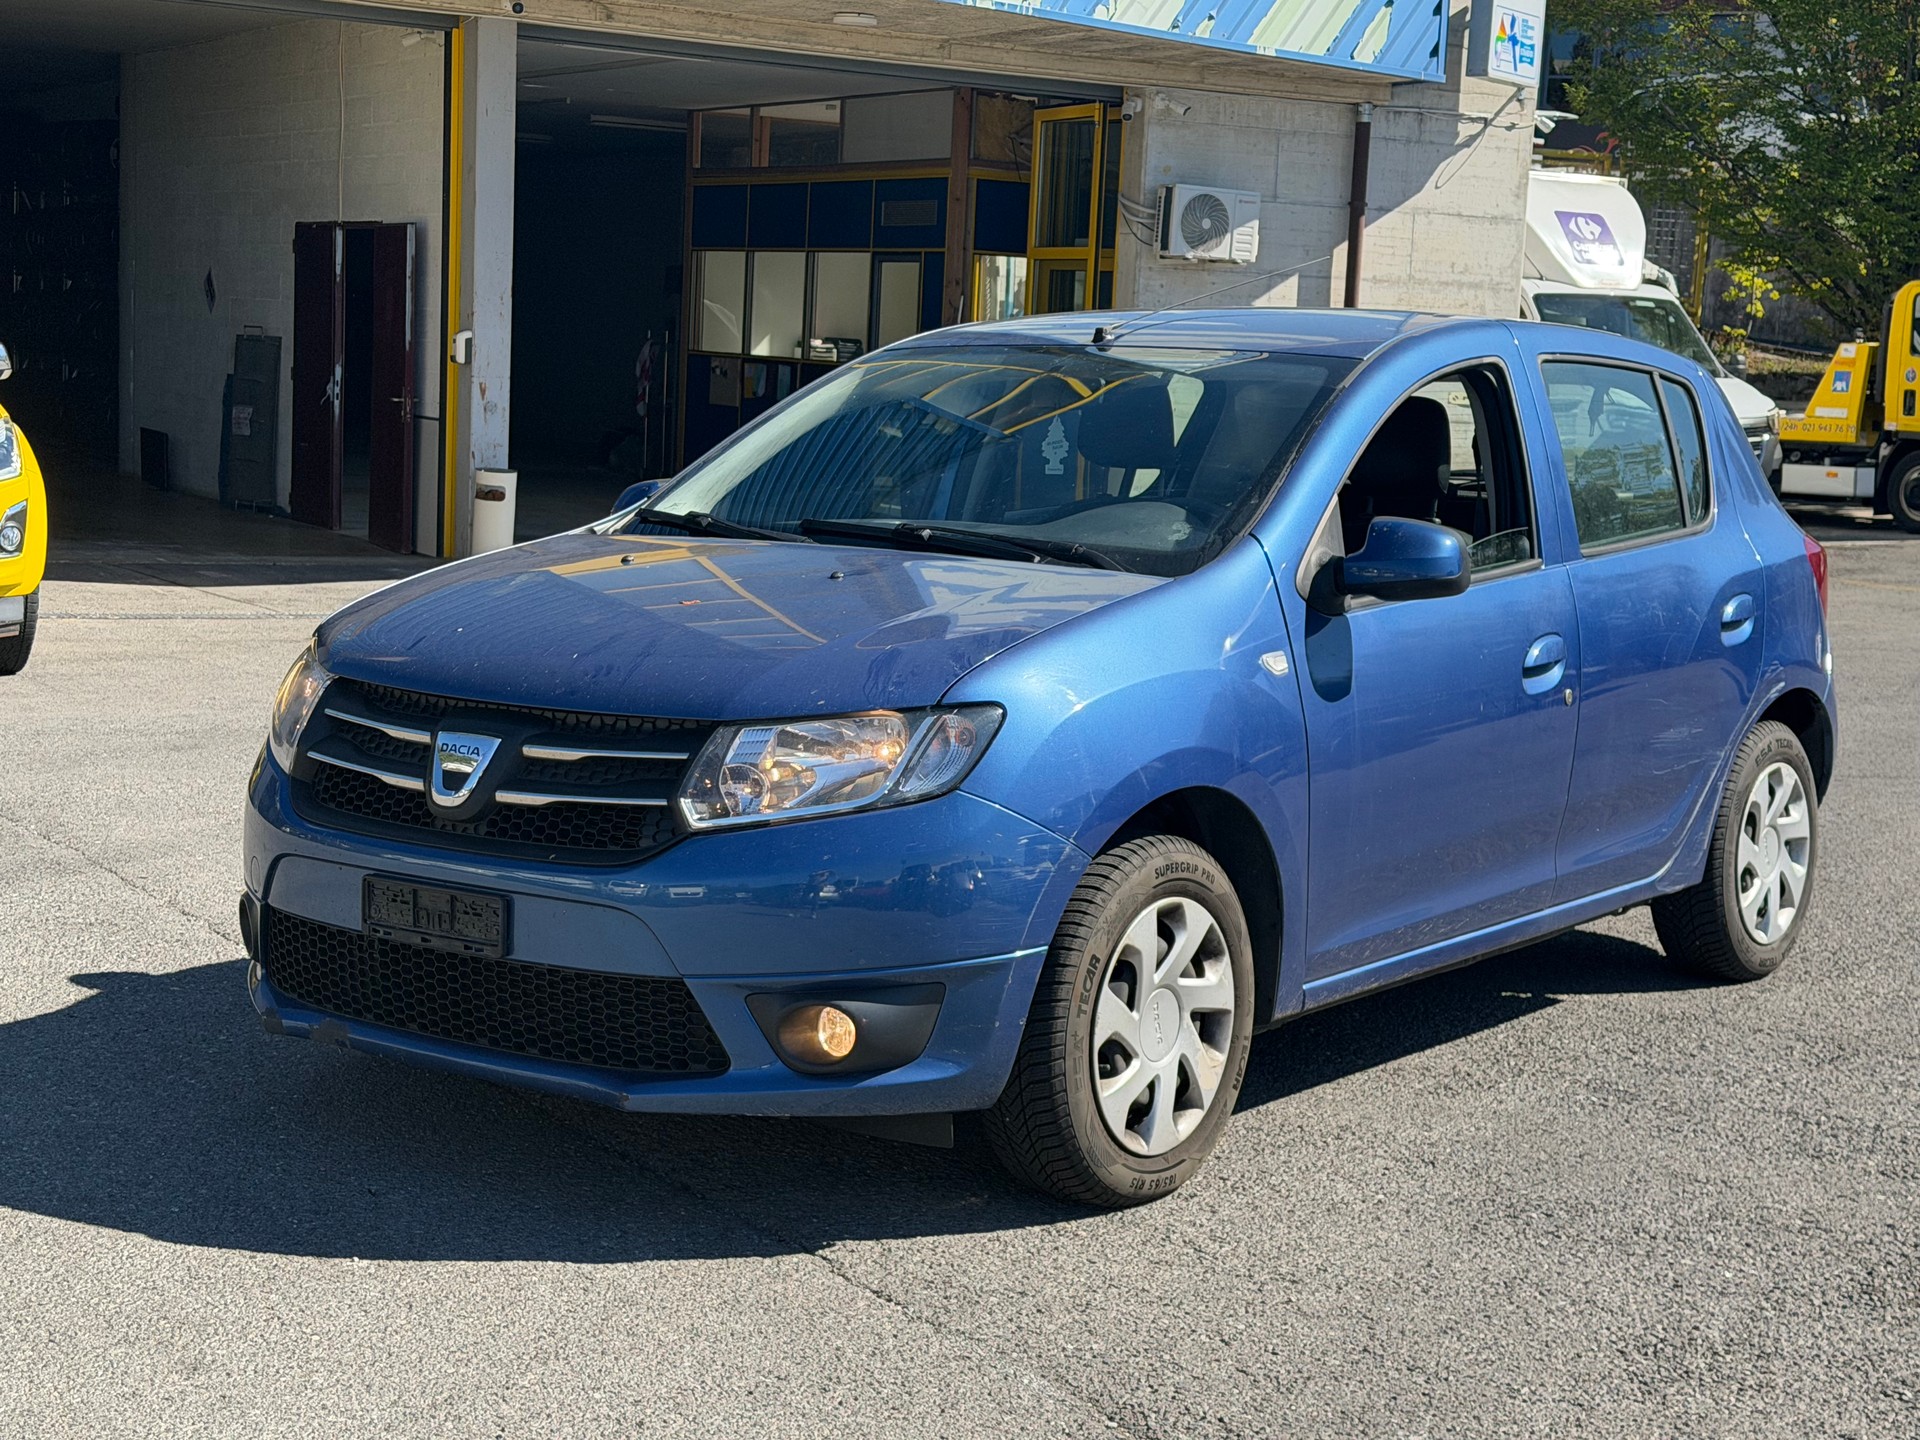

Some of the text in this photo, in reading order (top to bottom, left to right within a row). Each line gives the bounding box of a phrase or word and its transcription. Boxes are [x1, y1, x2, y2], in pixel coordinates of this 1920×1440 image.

[1802, 423, 1816, 433] 021
[1818, 423, 1832, 433] 943
[1835, 424, 1844, 433] 76
[441, 742, 480, 757] DACIA
[1154, 861, 1216, 885] SUPERGRIP PRO
[1077, 953, 1102, 1019] TECAR
[1129, 1173, 1177, 1191] 185/65 R15
